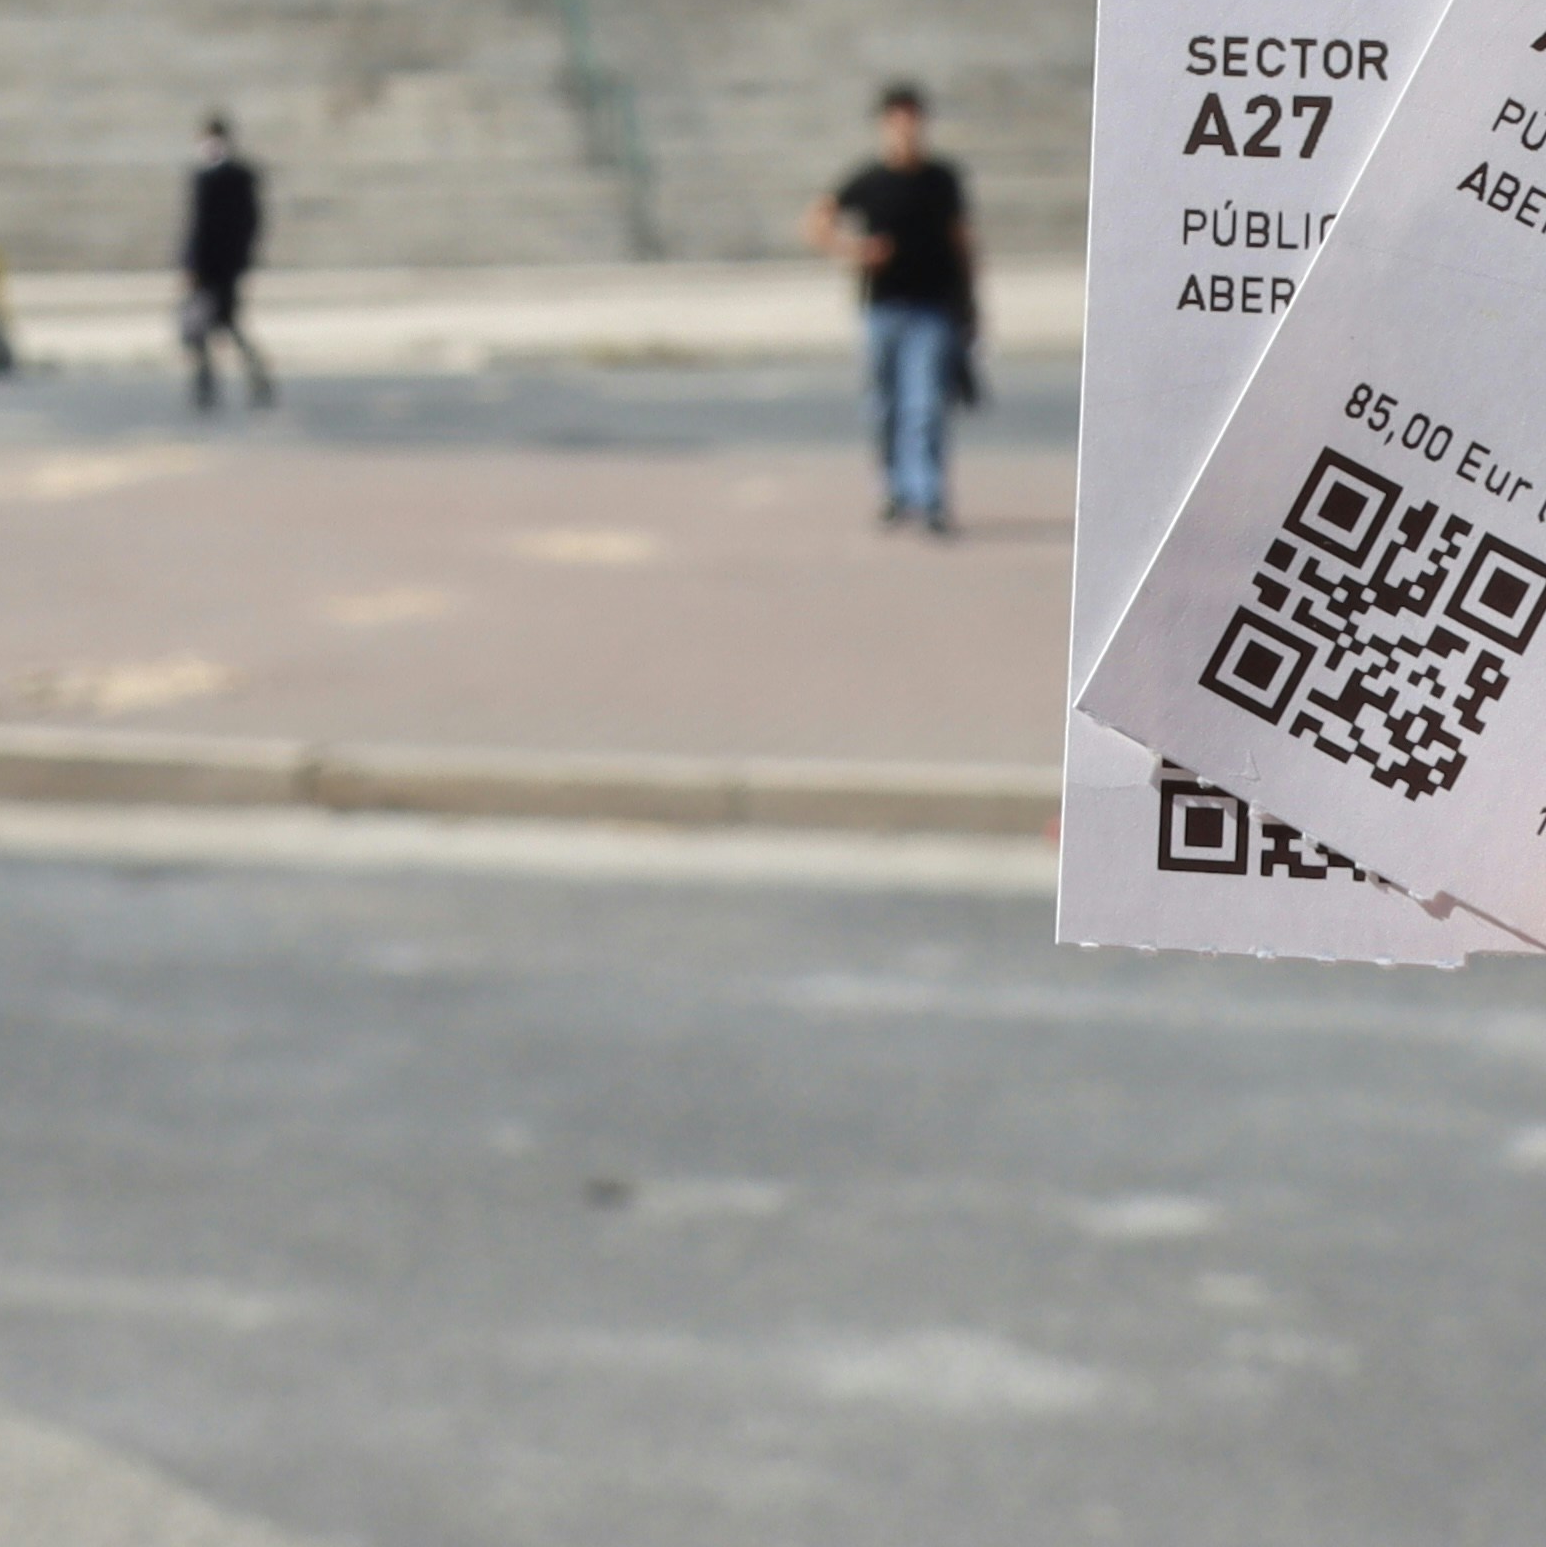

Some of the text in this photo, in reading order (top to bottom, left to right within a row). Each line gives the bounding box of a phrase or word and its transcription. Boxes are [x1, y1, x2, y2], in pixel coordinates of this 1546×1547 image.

[1185, 35, 1389, 82] SECTOR
[1182, 91, 1333, 160] A27
[1344, 382, 1454, 463] 85,00
[1455, 440, 1534, 503] Eur
